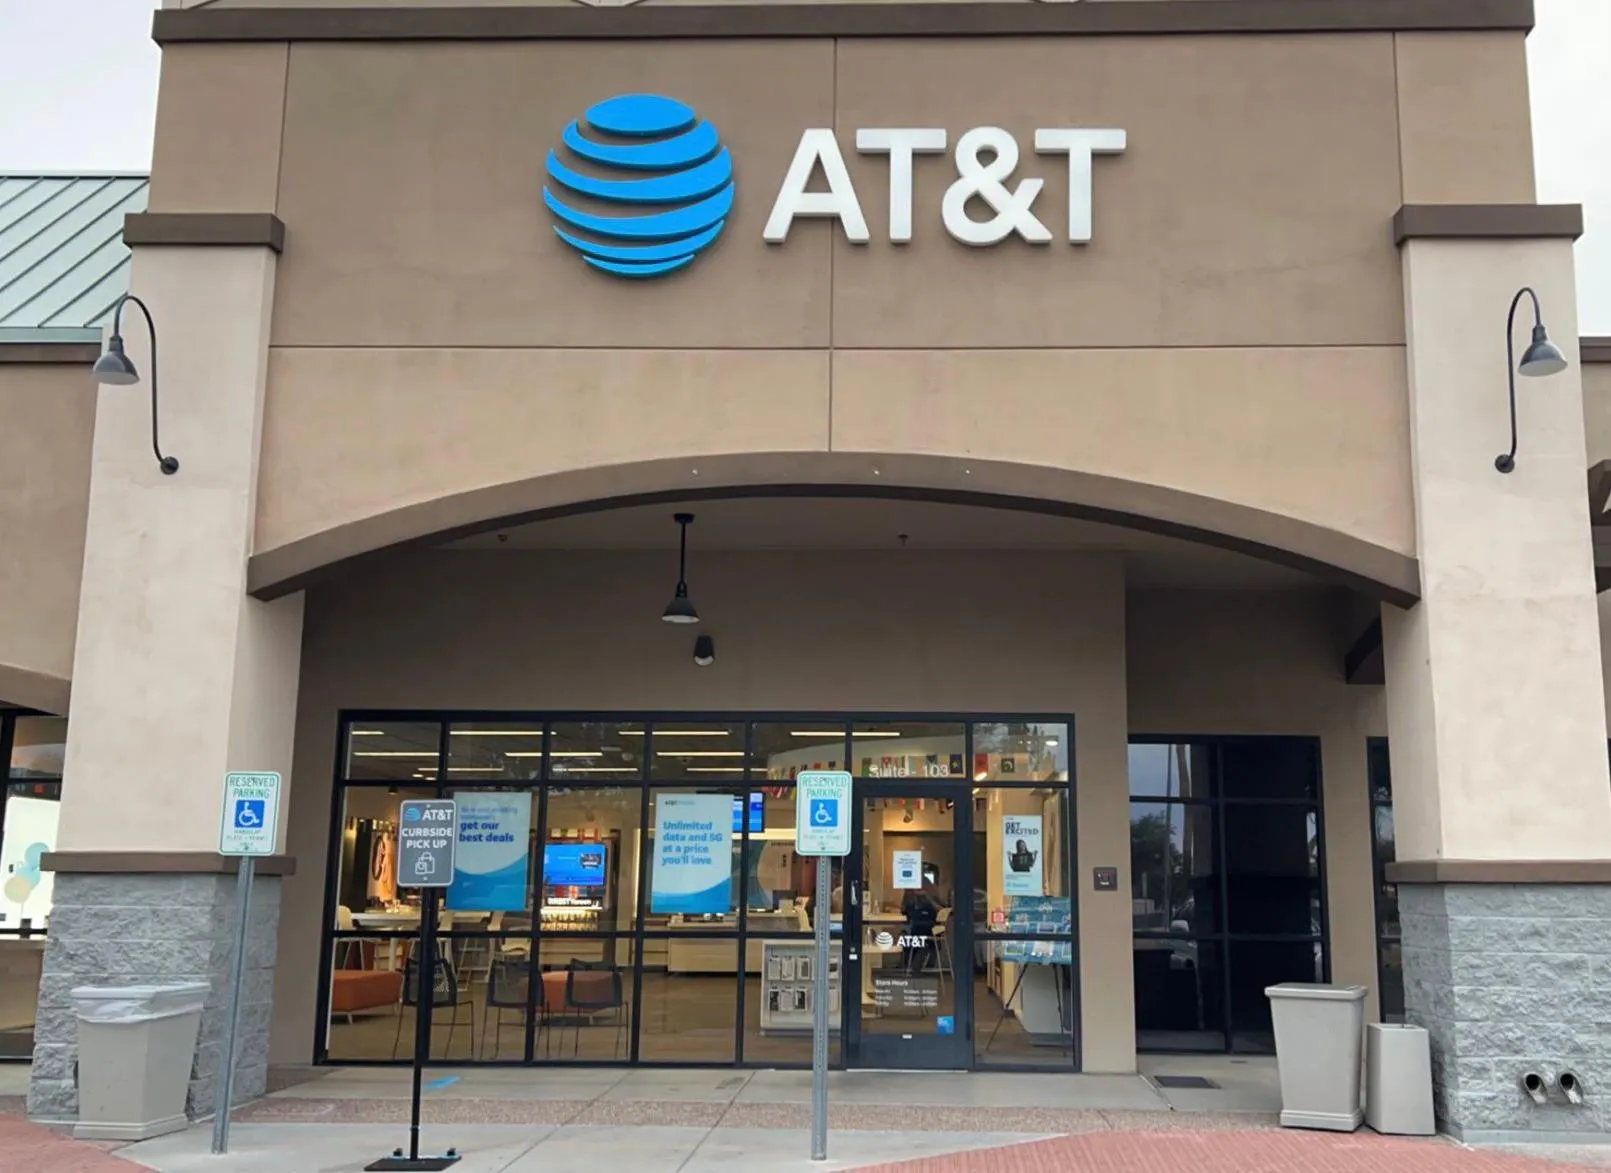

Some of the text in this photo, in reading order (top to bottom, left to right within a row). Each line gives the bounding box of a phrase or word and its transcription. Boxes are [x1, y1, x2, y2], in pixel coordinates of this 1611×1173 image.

[763, 126, 1127, 246] AT&T
[868, 764, 909, 778] Suite
[923, 764, 949, 778] 103
[229, 776, 275, 788] RESERVED
[802, 776, 847, 788] RESERVED
[233, 788, 270, 799] PARKING
[806, 788, 843, 798] PARKING
[422, 809, 453, 821] AT&T
[460, 821, 500, 831] get our
[663, 821, 713, 831] Unlimited
[401, 827, 453, 837] CURBSIDE
[459, 832, 515, 842] best deals
[663, 832, 724, 842] data and 5G
[406, 839, 448, 849] PICK UP
[662, 843, 709, 856] at a price
[662, 855, 713, 866] you'll love
[897, 936, 928, 948] AT&T
